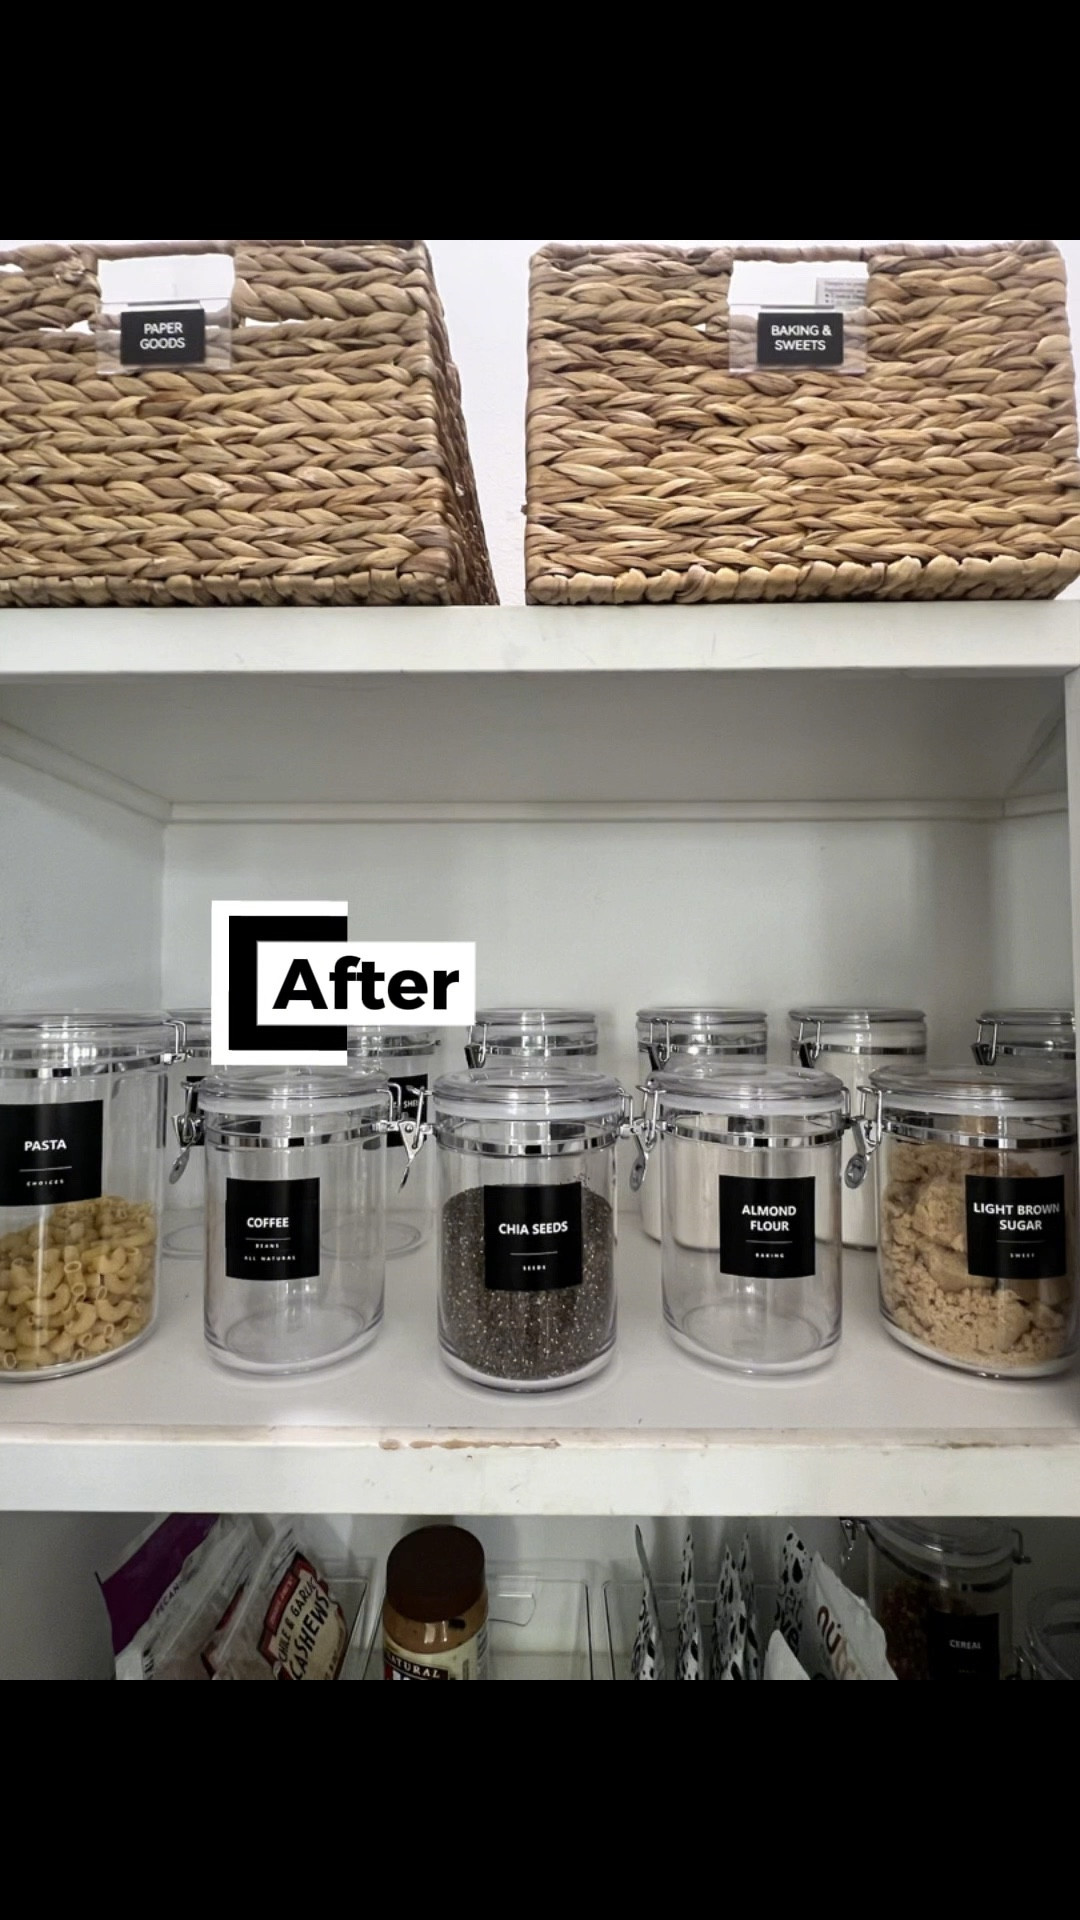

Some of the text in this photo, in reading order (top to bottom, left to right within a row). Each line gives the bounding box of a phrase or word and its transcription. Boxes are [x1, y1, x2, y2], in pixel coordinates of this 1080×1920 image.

[143, 322, 183, 334] PAPER
[771, 324, 832, 336] BAKING &
[140, 337, 186, 350] GOODS
[774, 340, 827, 351] SWEETS
[24, 1139, 67, 1151] PASTA
[741, 1204, 797, 1217] ALMOND
[973, 1202, 1060, 1216] LIGHT BROWN
[246, 1216, 290, 1228] COFFEE
[498, 1220, 569, 1236] CHIA SEEDS
[750, 1220, 790, 1232] FLOUR
[999, 1219, 1043, 1232] SUGAR
[289, 1590, 330, 1680] CASHEWS
